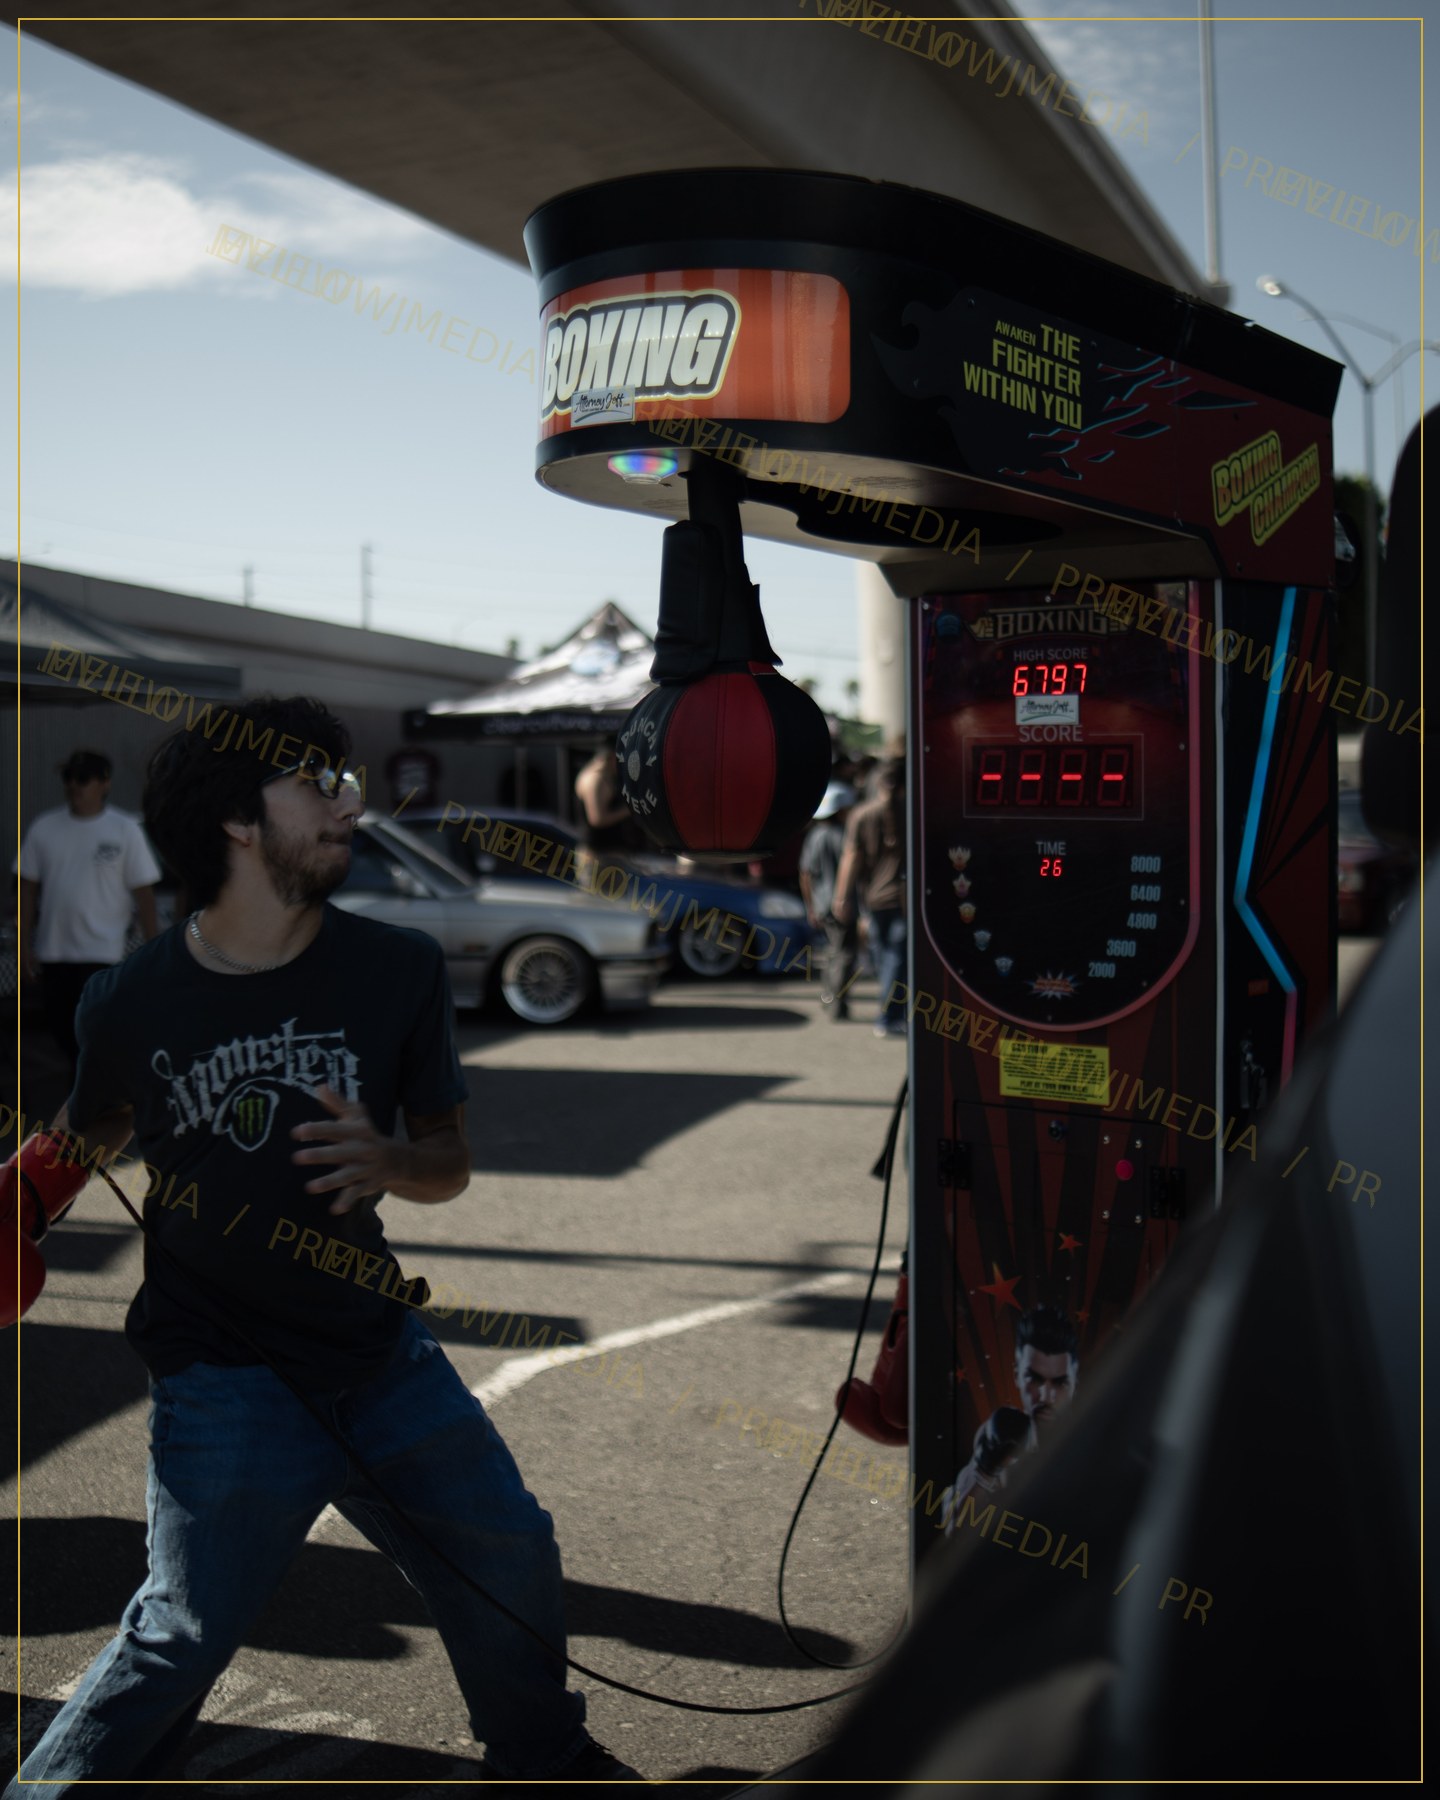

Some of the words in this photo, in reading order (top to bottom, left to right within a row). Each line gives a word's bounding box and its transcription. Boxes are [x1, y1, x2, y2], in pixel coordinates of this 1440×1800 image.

[995, 320, 1037, 347] AWAKEN
[1040, 323, 1081, 365] THE
[542, 302, 729, 409] BOXING
[992, 338, 1081, 397] FIGHTER
[963, 361, 1037, 415] WITHIN
[1041, 390, 1082, 430] YOU
[1214, 434, 1280, 520] BOXING
[997, 610, 1107, 638] BOXING
[1013, 649, 1044, 662] HIGH
[1047, 647, 1089, 660] SCORE
[1012, 663, 1088, 697] 6797
[621, 718, 658, 750] PUNCH
[1018, 725, 1083, 742] SCORE
[621, 784, 658, 815] HERE
[1036, 841, 1067, 856] TIME
[1039, 858, 1063, 877] 26
[1130, 855, 1161, 873] 8000
[1130, 885, 1161, 902] 6400
[1127, 913, 1157, 930] 4800
[1106, 939, 1137, 957] 3600
[1088, 962, 1116, 979] 2000
